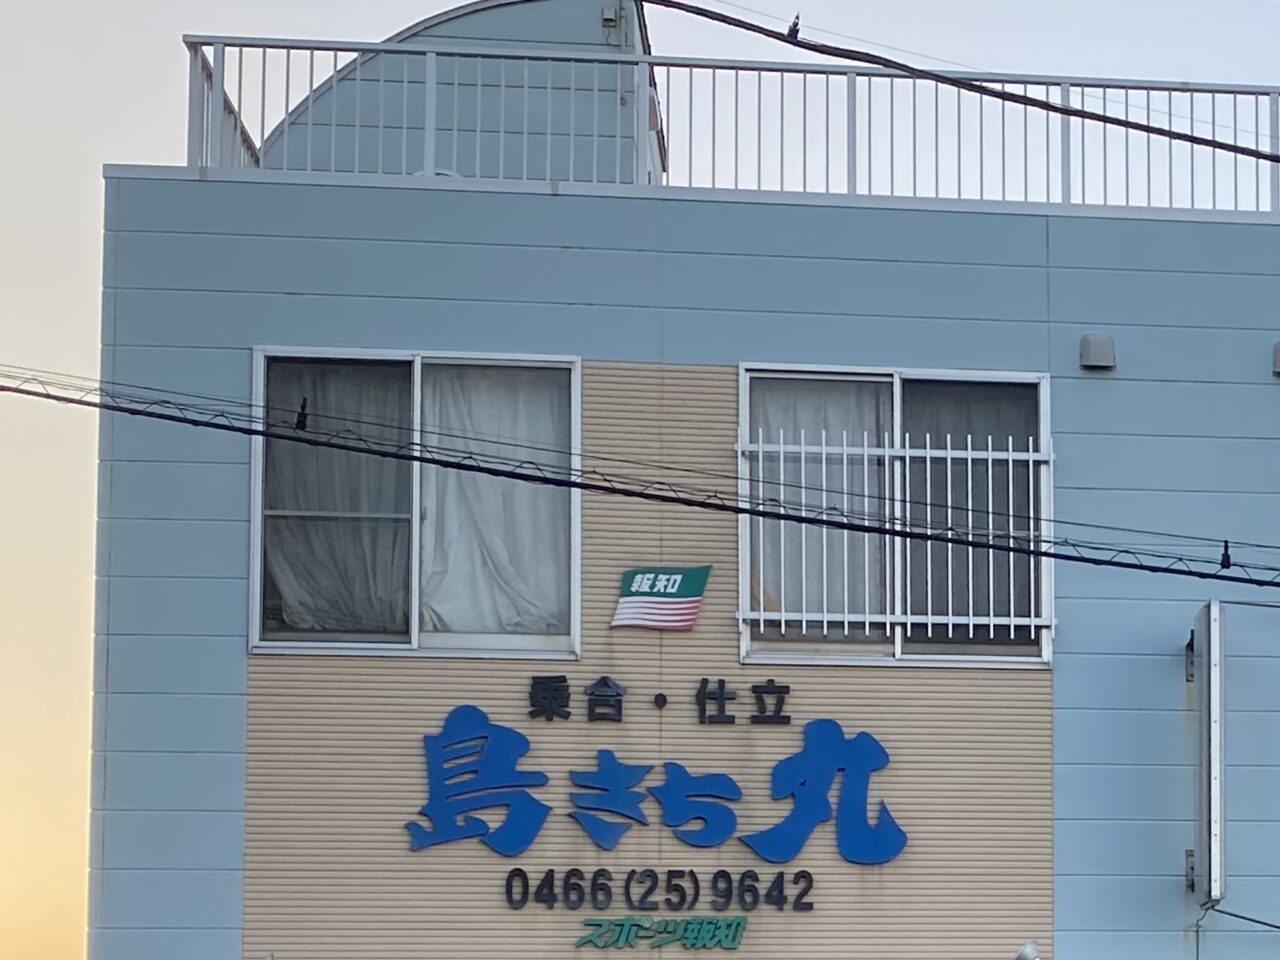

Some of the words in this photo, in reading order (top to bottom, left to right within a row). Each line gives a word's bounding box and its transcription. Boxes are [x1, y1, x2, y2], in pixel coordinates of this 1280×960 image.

[628, 572, 684, 594] 報知
[404, 704, 909, 866] 島きち丸
[504, 867, 815, 913] 0466(25)9642
[575, 916, 748, 950] スポーツ報知
